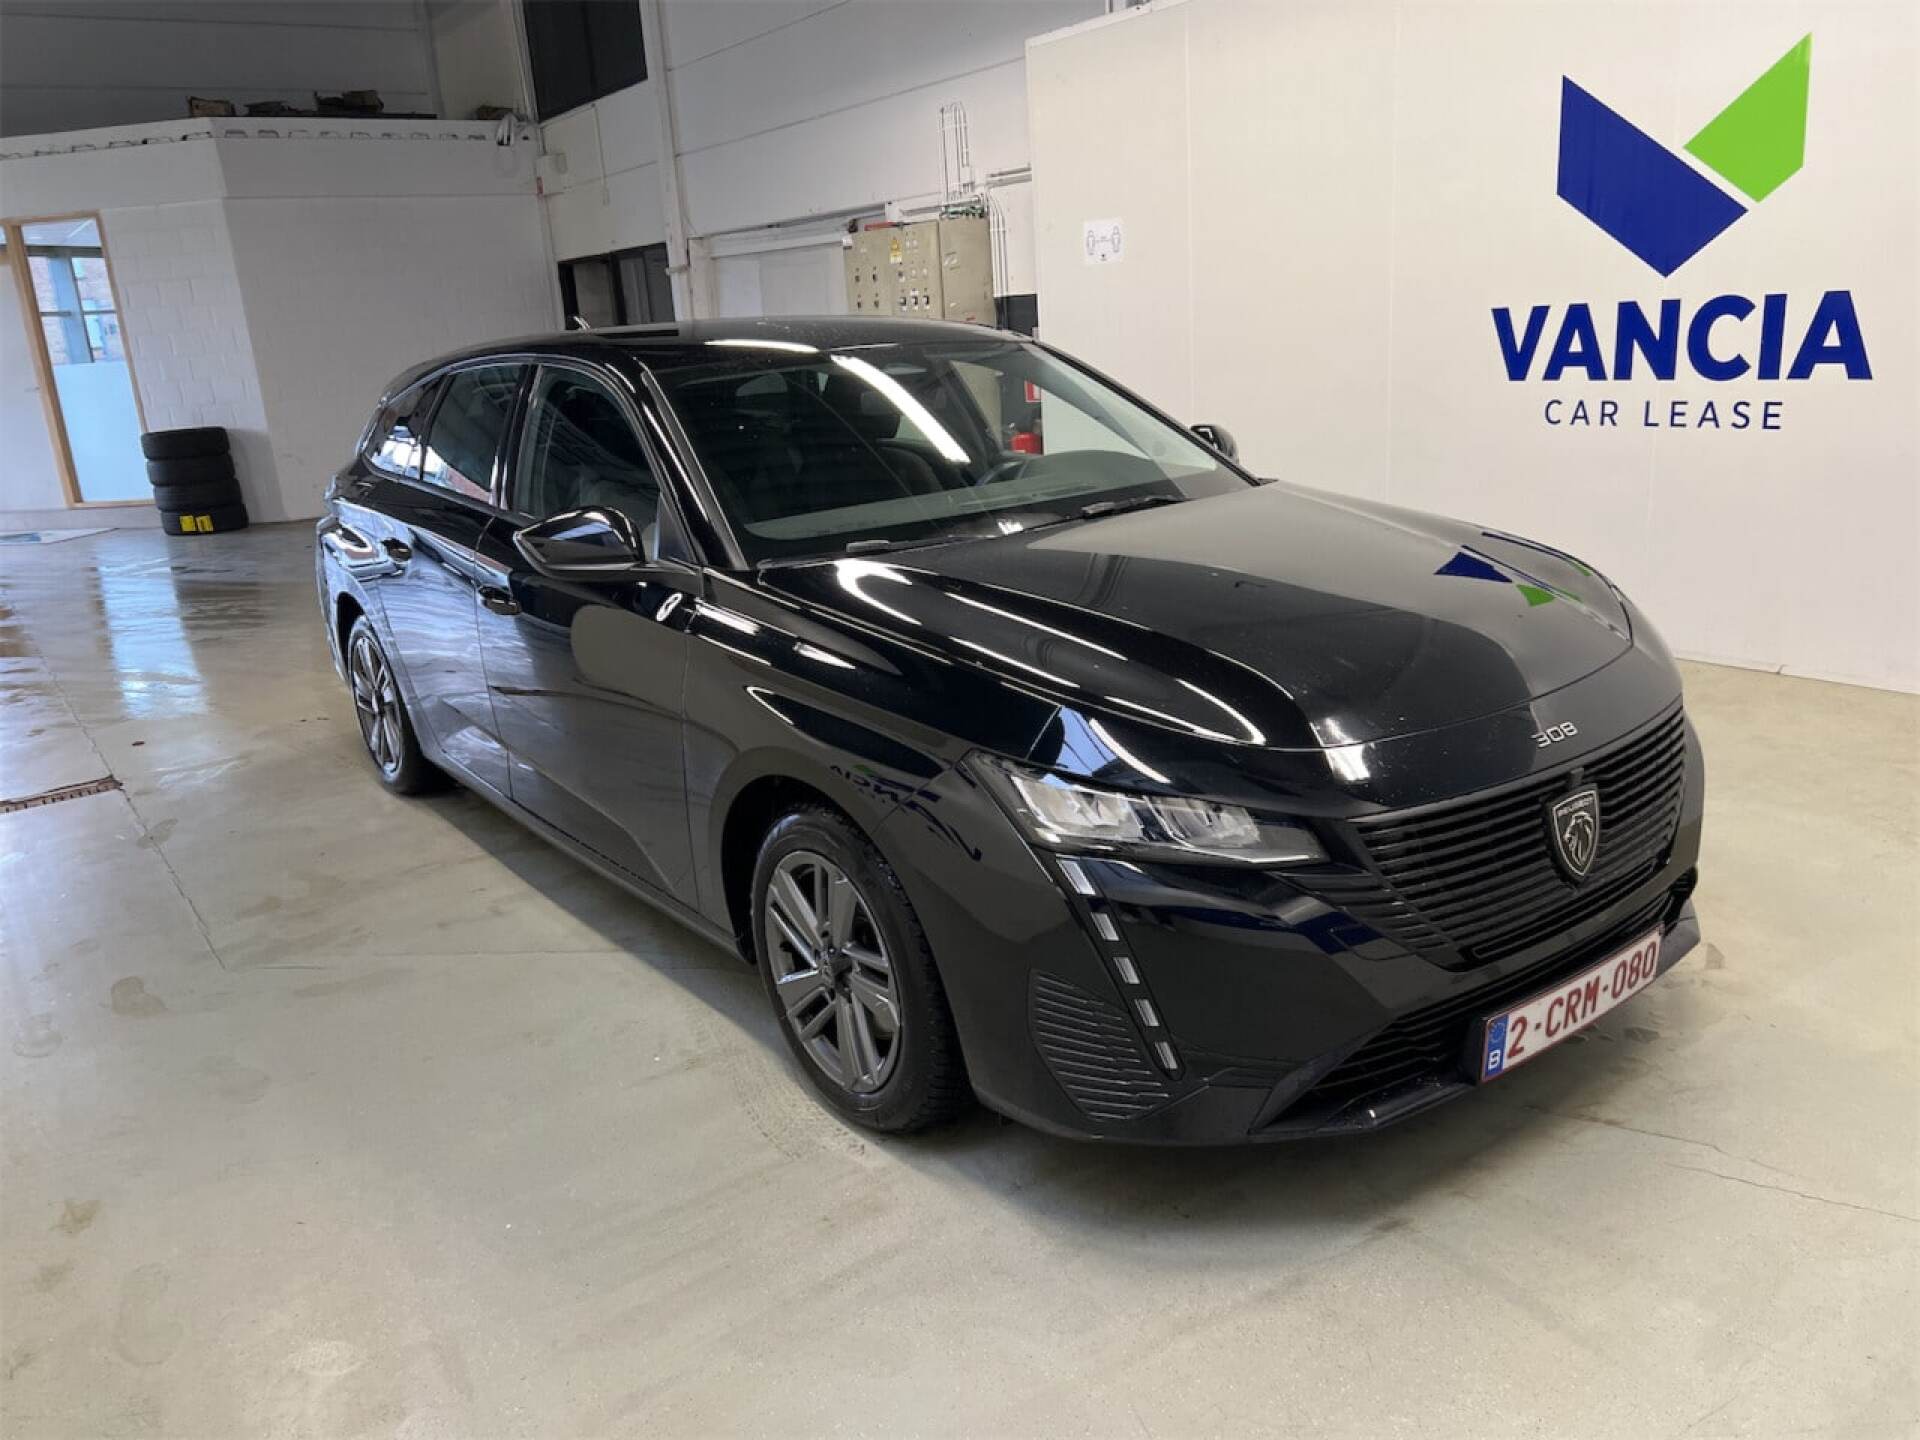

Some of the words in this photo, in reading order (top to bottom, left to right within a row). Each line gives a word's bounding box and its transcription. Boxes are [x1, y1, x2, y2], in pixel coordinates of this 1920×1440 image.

[1491, 290, 1873, 382] VANCIA
[1544, 400, 1619, 427] CAR
[1643, 401, 1784, 431] LEASE
[1531, 722, 1578, 748] 308
[1507, 941, 1658, 1060] 2-CRM-080
[1487, 1050, 1501, 1072] B
